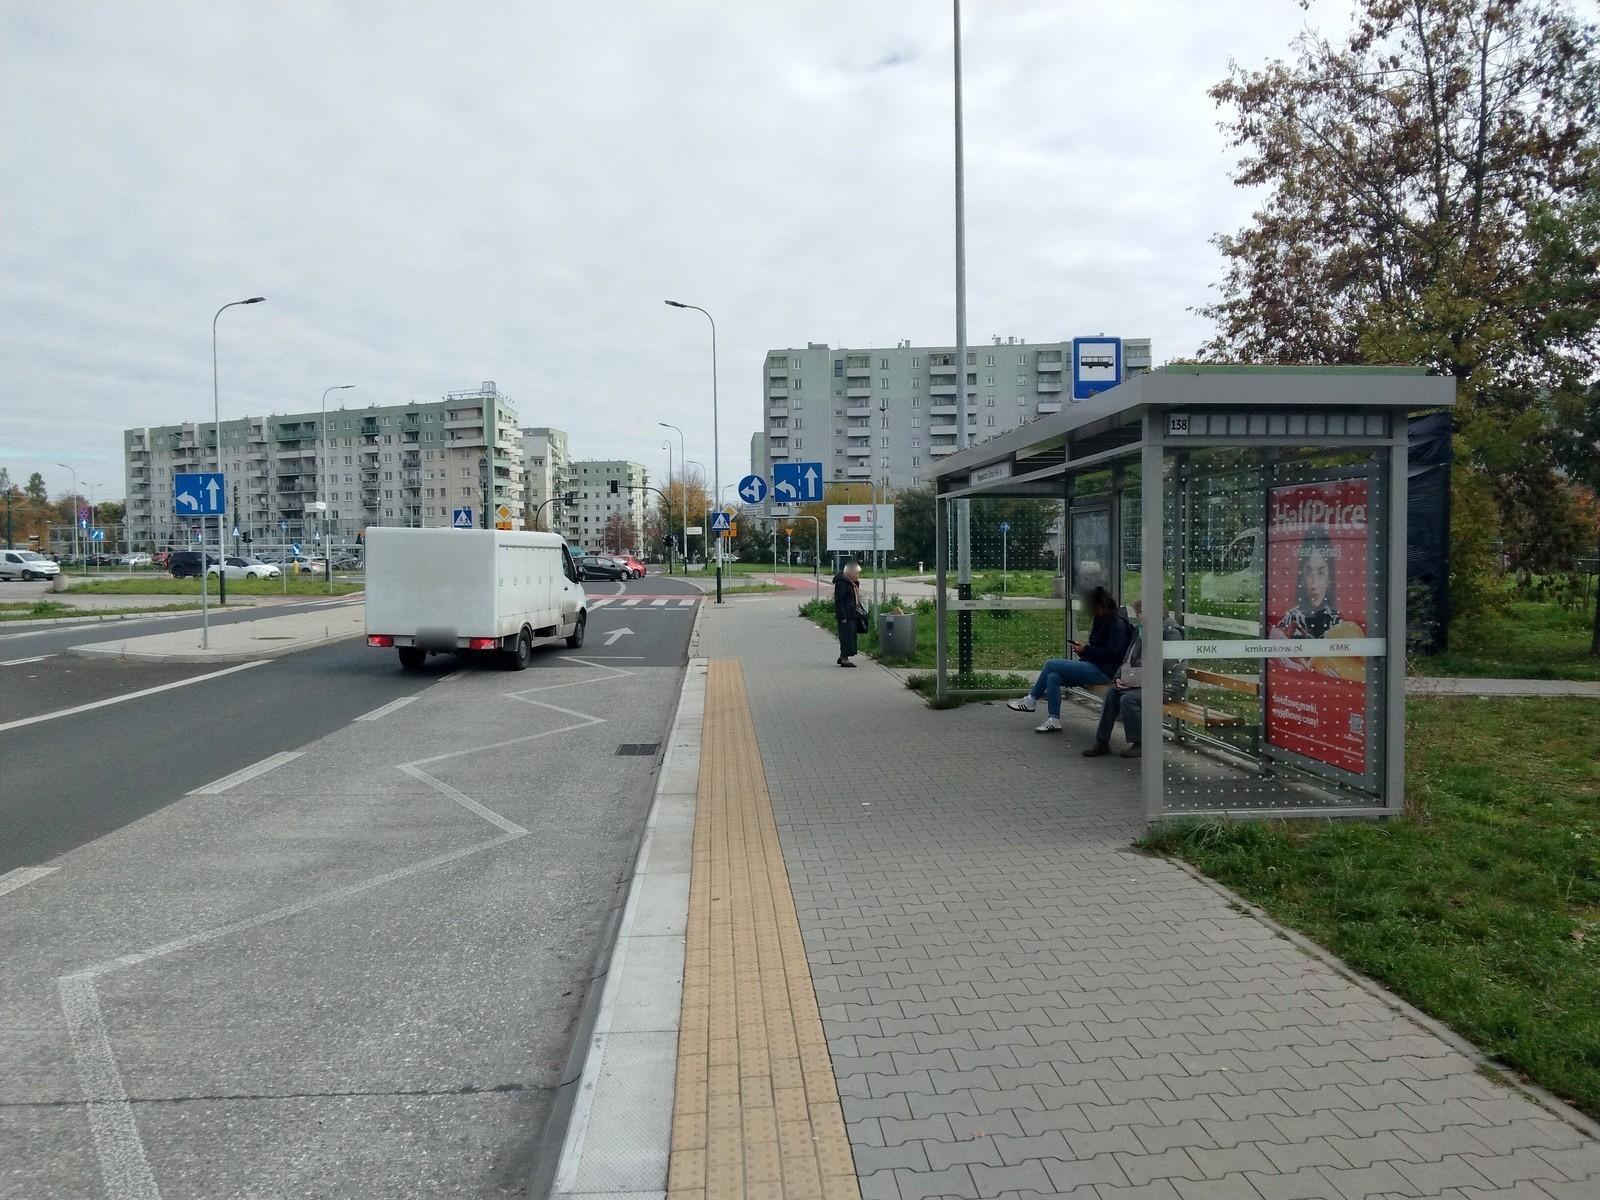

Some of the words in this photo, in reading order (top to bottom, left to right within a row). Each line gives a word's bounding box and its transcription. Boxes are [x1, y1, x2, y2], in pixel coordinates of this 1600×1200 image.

[1171, 419, 1187, 430] 138
[1275, 499, 1365, 532] HalfPrice
[1312, 544, 1342, 557] ands
[1196, 644, 1217, 654] KMK
[1244, 643, 1303, 653] kmkrakow.pl
[1329, 643, 1350, 652] KMK
